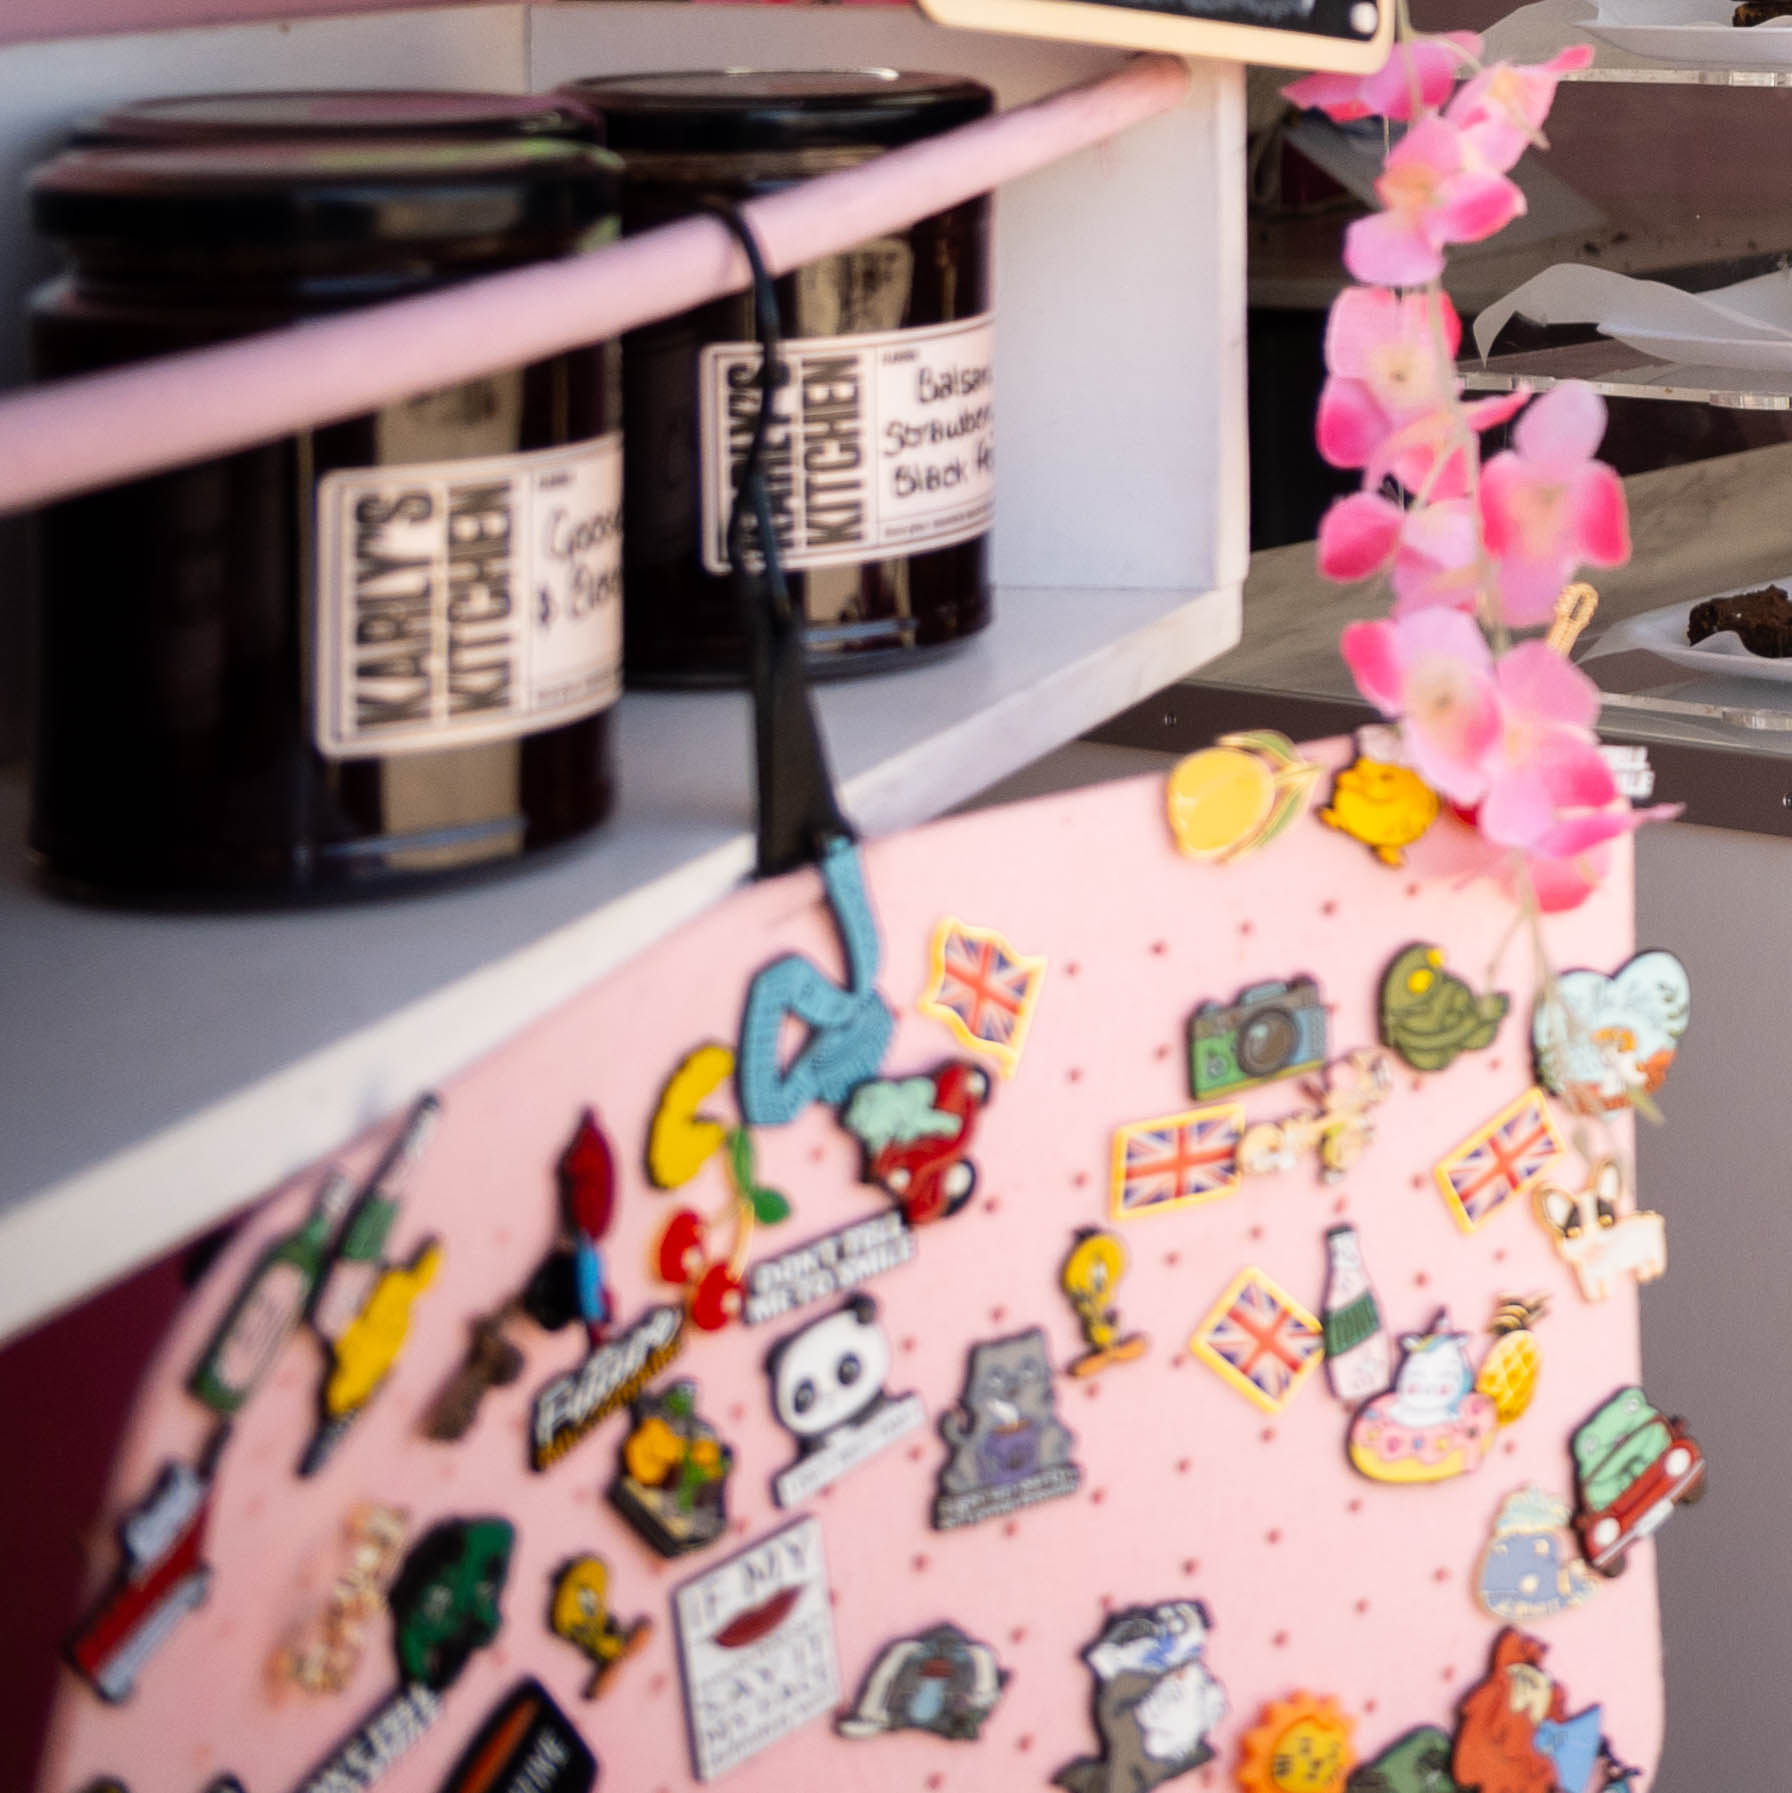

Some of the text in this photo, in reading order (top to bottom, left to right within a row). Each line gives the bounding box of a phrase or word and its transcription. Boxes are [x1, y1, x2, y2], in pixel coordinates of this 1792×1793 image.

[802, 355, 863, 546] KITCHEN
[355, 492, 432, 726] KARLY'S
[449, 481, 512, 714] KITCHEN
